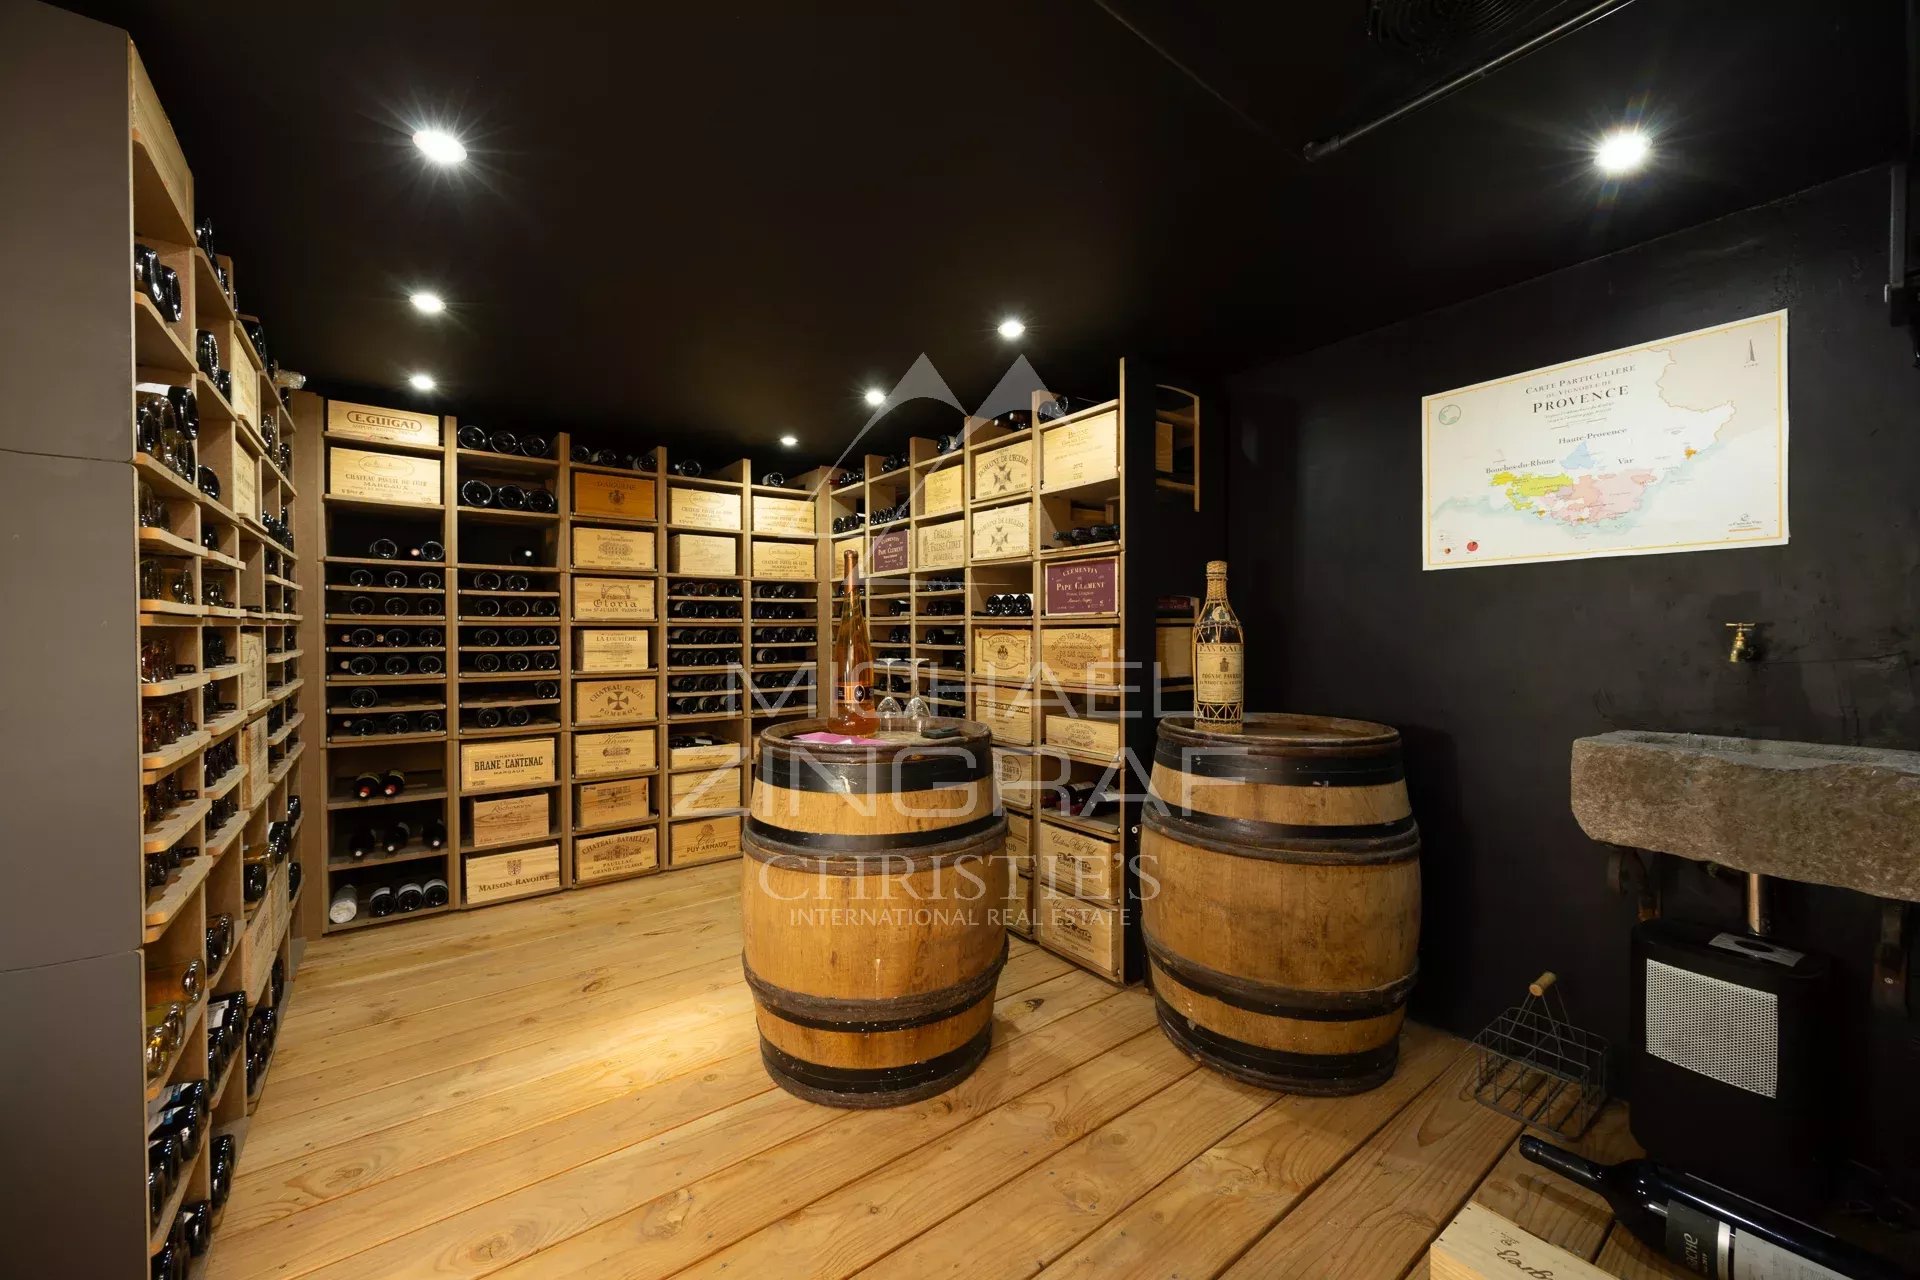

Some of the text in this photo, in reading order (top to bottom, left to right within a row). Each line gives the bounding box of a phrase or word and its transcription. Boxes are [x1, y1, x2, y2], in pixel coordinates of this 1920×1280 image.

[1526, 382, 1558, 394] CARTE
[1532, 384, 1629, 413] PROVENCE
[1558, 428, 1628, 444] Haute-Provence
[1618, 457, 1635, 465] Var
[1056, 582, 1072, 591] PAPE
[593, 599, 638, 608] Gloria
[589, 684, 646, 702] CHATEAU GAZIN
[599, 706, 638, 717] POMEROL
[582, 838, 614, 855] CHATEAU
[686, 841, 728, 853] PUY ARNAUD
[602, 858, 633, 868] PAUILLAC
[478, 874, 550, 892] MAISON RAVOIRE
